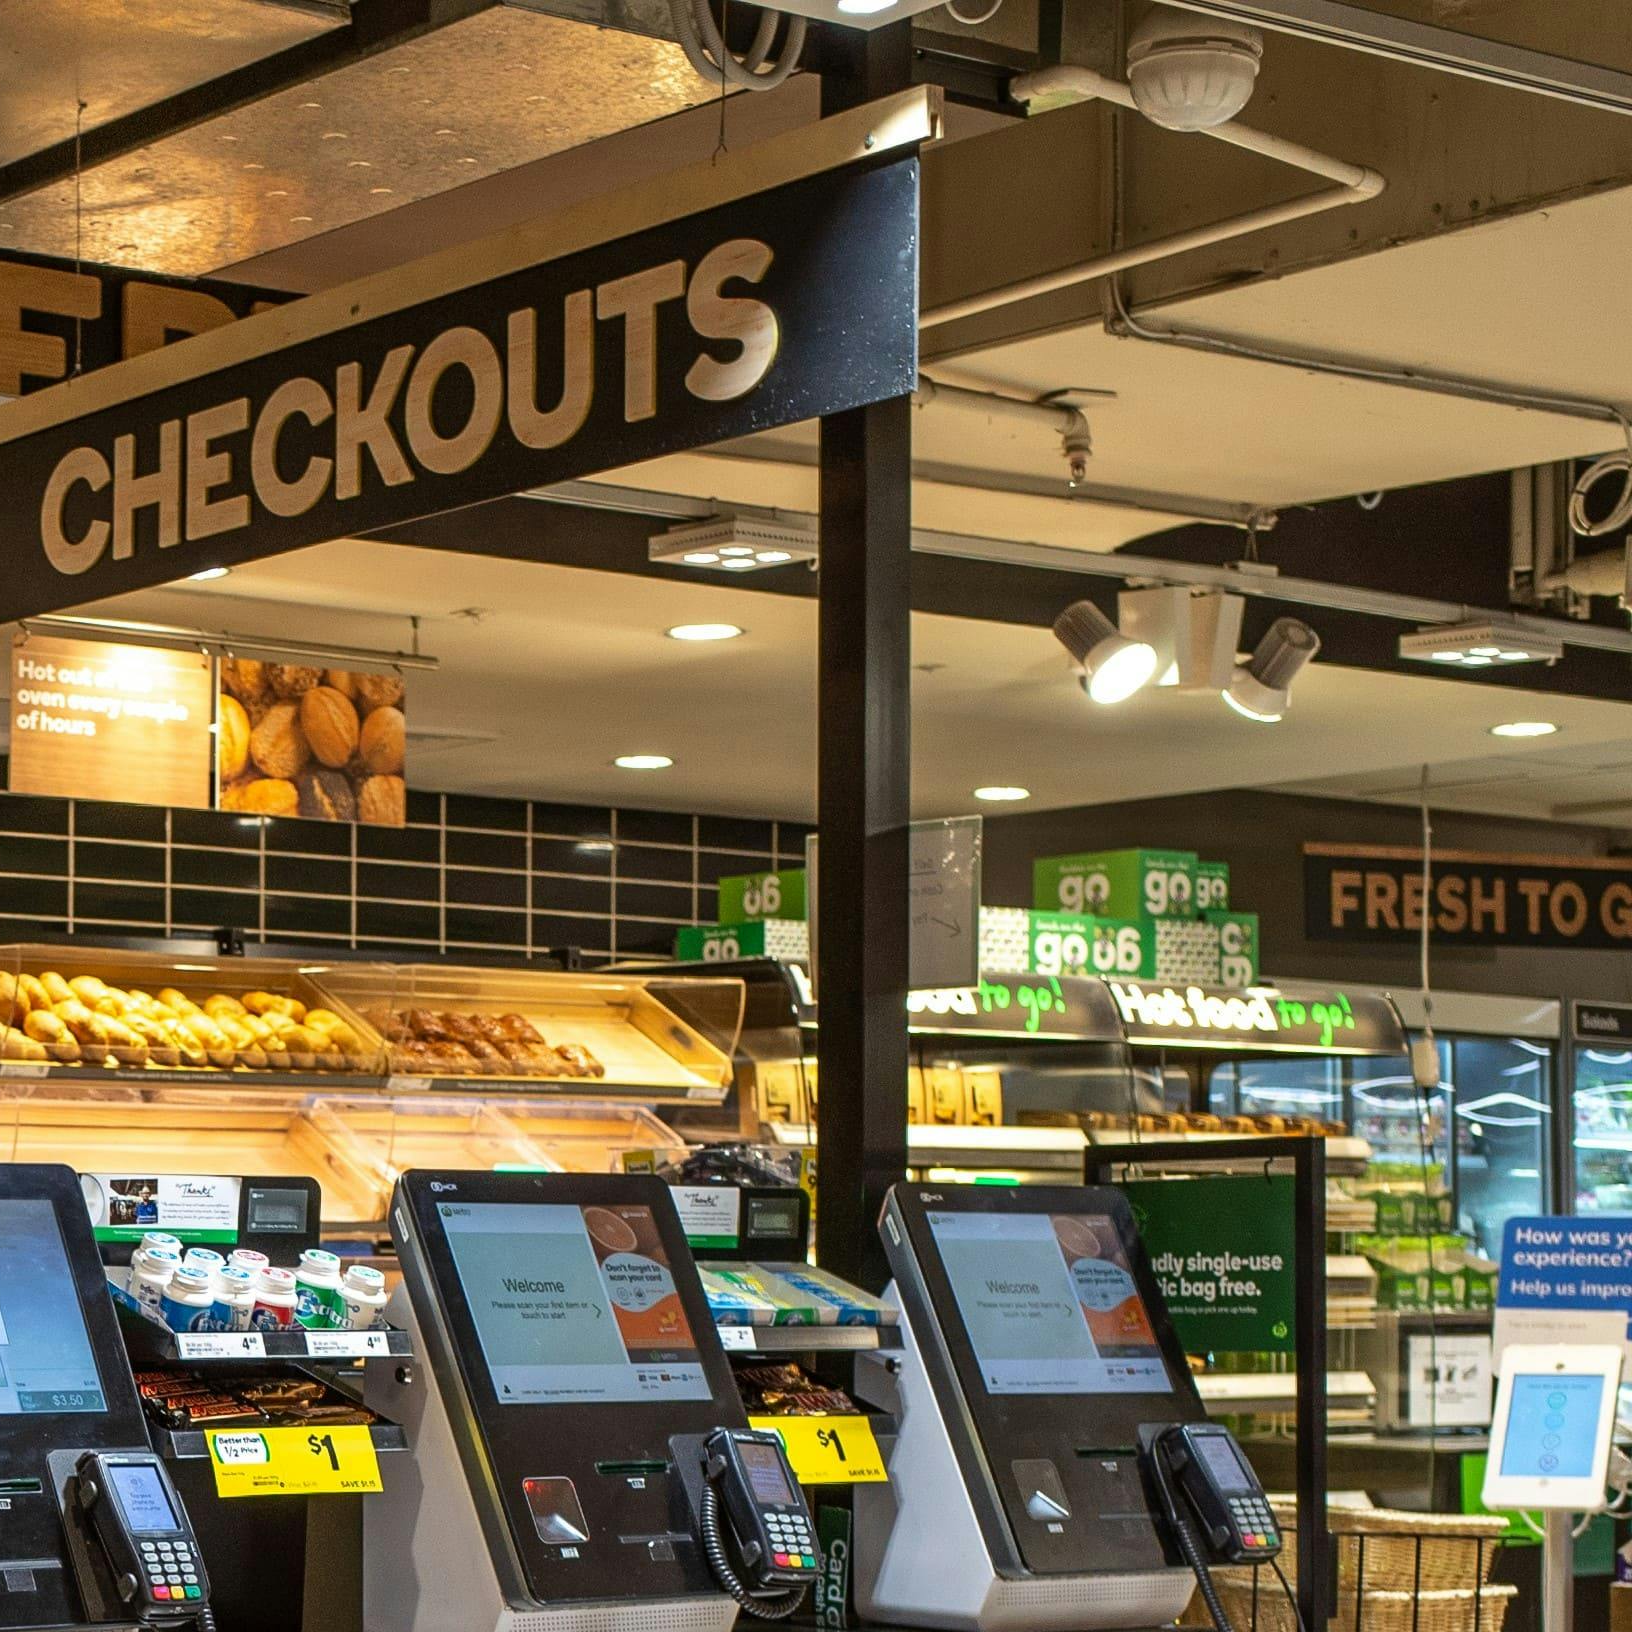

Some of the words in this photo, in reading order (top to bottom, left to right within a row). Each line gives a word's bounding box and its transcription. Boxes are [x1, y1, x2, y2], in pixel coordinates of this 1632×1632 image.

[41, 239, 778, 575] CHECKOUTS
[18, 659, 56, 682] Hot
[58, 669, 93, 687] out
[18, 689, 66, 708] oven
[68, 694, 122, 720] every
[17, 710, 39, 730] of
[40, 711, 97, 737] hours
[1144, 870, 1191, 915] go
[1196, 876, 1227, 908] go
[1330, 870, 1506, 933] FRESH
[1518, 879, 1588, 937] TO
[1035, 931, 1088, 976] go
[979, 977, 1010, 1012] to
[1018, 976, 1066, 1032] go!
[1109, 983, 1192, 1027] Hot
[1187, 986, 1280, 1031] food
[1277, 989, 1306, 1028] to
[1311, 992, 1355, 1046] go!
[1515, 1227, 1562, 1246] How
[1568, 1230, 1611, 1246] was
[605, 1263, 626, 1272] Don't
[627, 1263, 650, 1274] forget
[652, 1263, 660, 1272] to
[1186, 1251, 1283, 1277] single-use
[1513, 1249, 1631, 1268] experience?
[502, 1278, 565, 1293] Welcome
[628, 1274, 645, 1283] your
[985, 1280, 1040, 1294] Welcome
[1180, 1278, 1216, 1302] bag
[1219, 1277, 1262, 1297] free.
[1510, 1279, 1551, 1298] Help
[1556, 1281, 1576, 1296] us
[297, 1296, 354, 1329] Extra
[492, 1301, 516, 1309] Please
[535, 1302, 550, 1311] your
[521, 1311, 540, 1319] touch
[542, 1311, 549, 1319] to
[551, 1311, 566, 1319] start
[53, 1394, 84, 1406] $3.50
[218, 1437, 241, 1446] Better
[242, 1436, 261, 1444] than
[225, 1446, 239, 1458] 1/2
[240, 1447, 258, 1455] Price
[307, 1434, 340, 1471] $1
[816, 1427, 846, 1461] $1
[827, 1539, 847, 1603] Card
